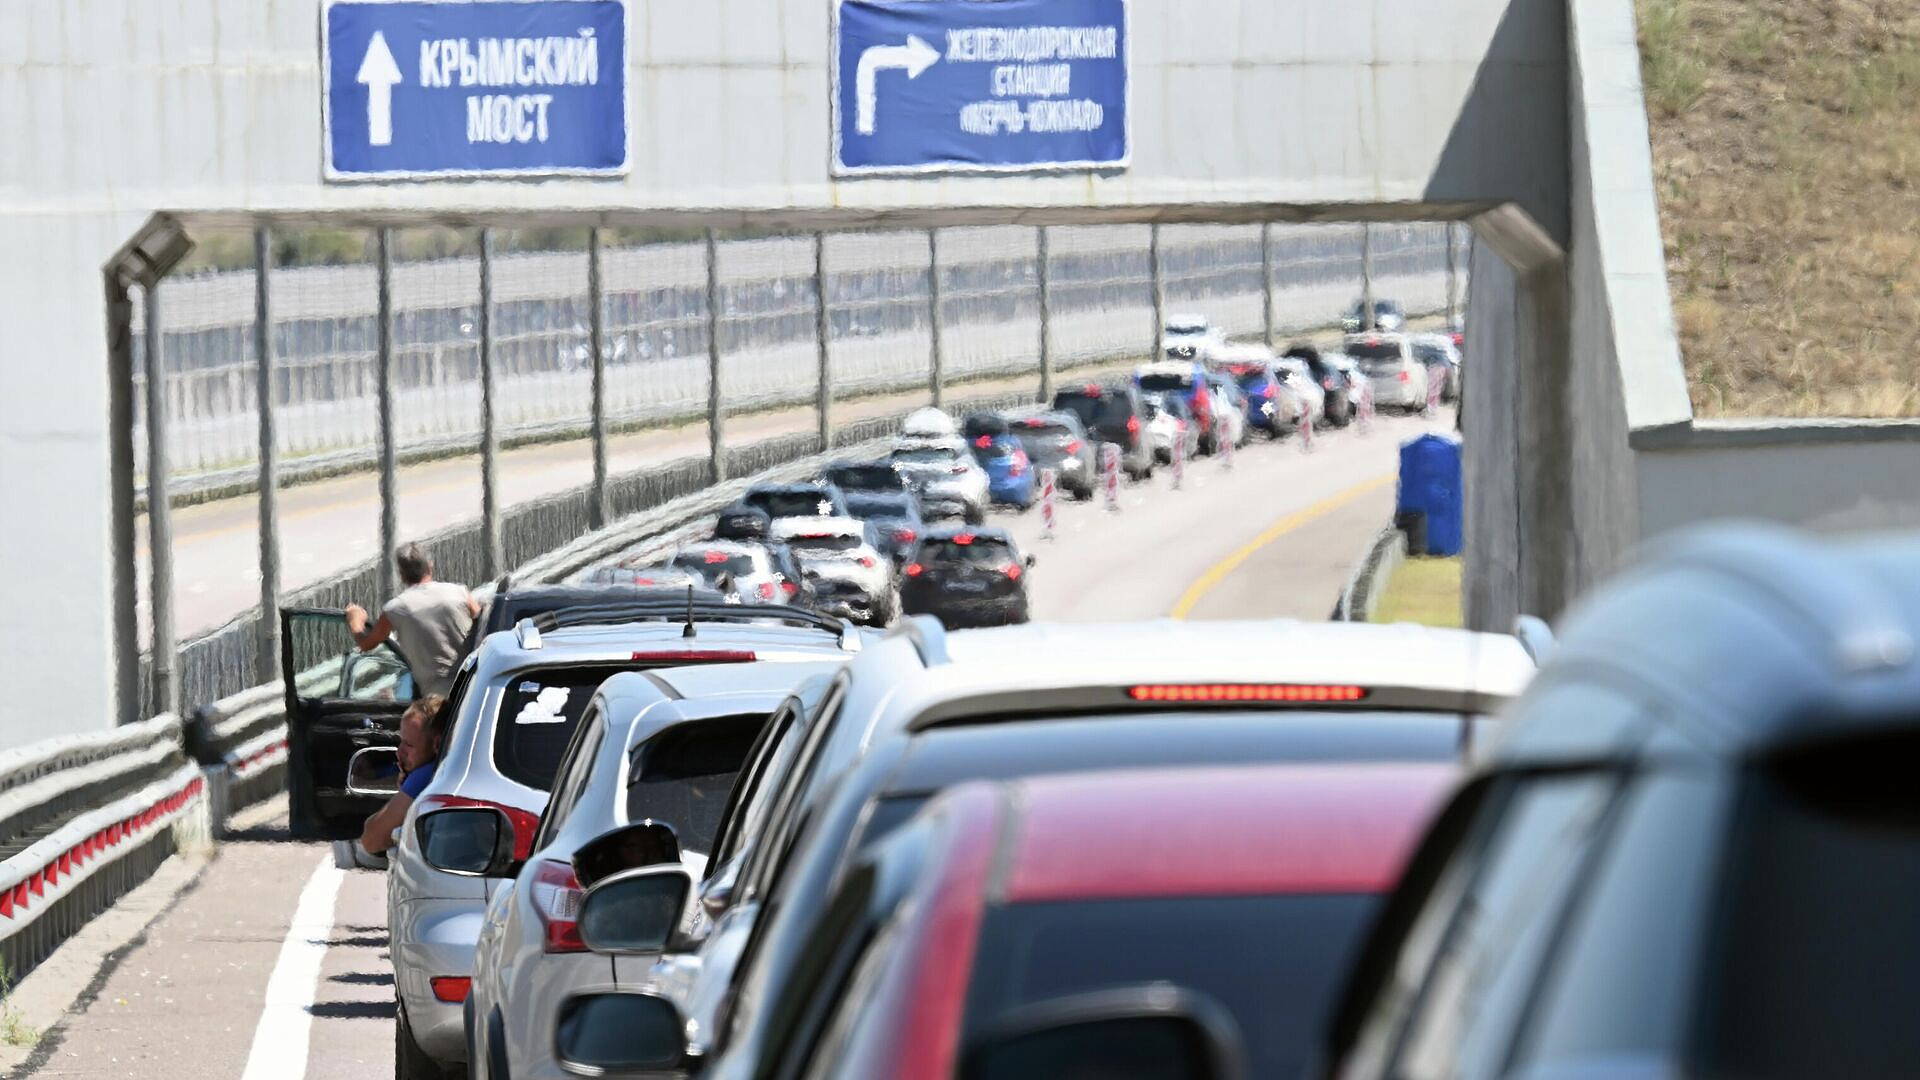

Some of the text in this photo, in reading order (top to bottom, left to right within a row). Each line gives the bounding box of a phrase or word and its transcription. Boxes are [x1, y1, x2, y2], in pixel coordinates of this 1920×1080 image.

[420, 27, 599, 87] КРЫМСКИЙ
[945, 26, 1116, 62] ЖЕЛЕЗНОДОРОЖНАЯ
[992, 63, 1071, 97] СТАНЦИЯ
[466, 94, 553, 144] МОСТ
